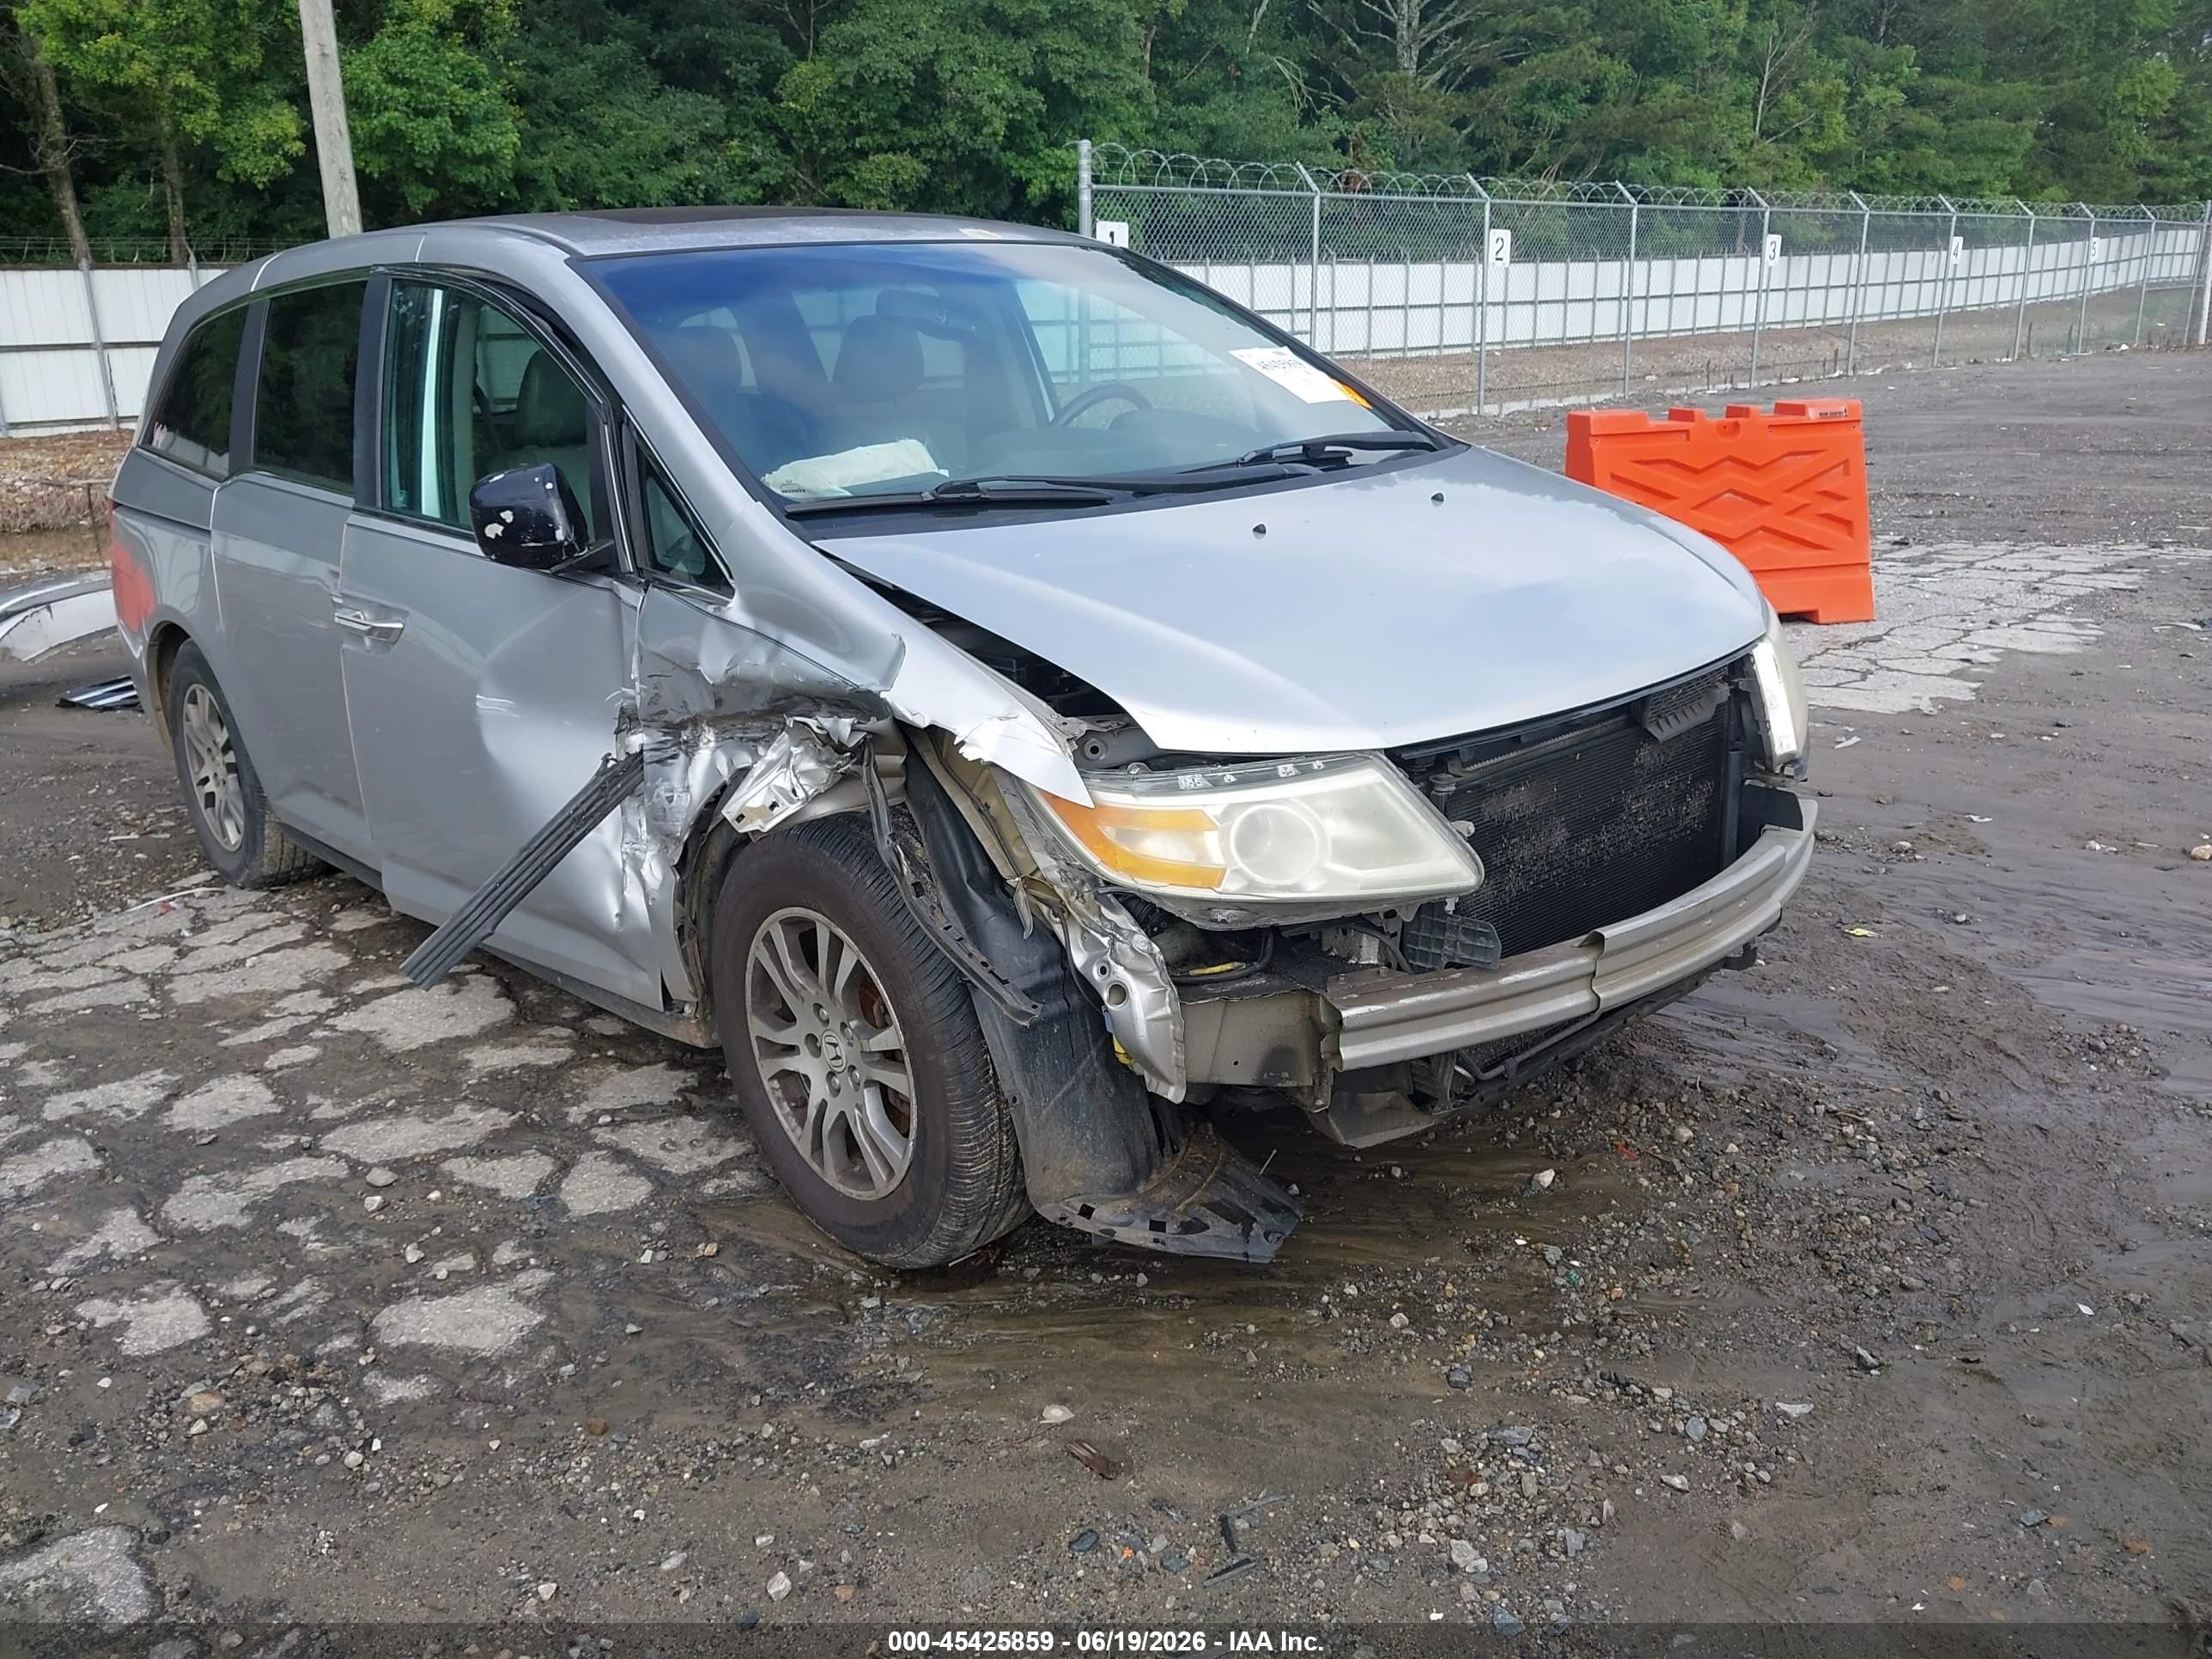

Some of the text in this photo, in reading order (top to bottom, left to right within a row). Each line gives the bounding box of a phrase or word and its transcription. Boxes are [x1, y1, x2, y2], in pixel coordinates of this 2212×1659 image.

[1495, 237, 1504, 261] 2
[1769, 240, 1777, 261] 3
[1953, 241, 1960, 259] 4
[2091, 241, 2097, 258] 5
